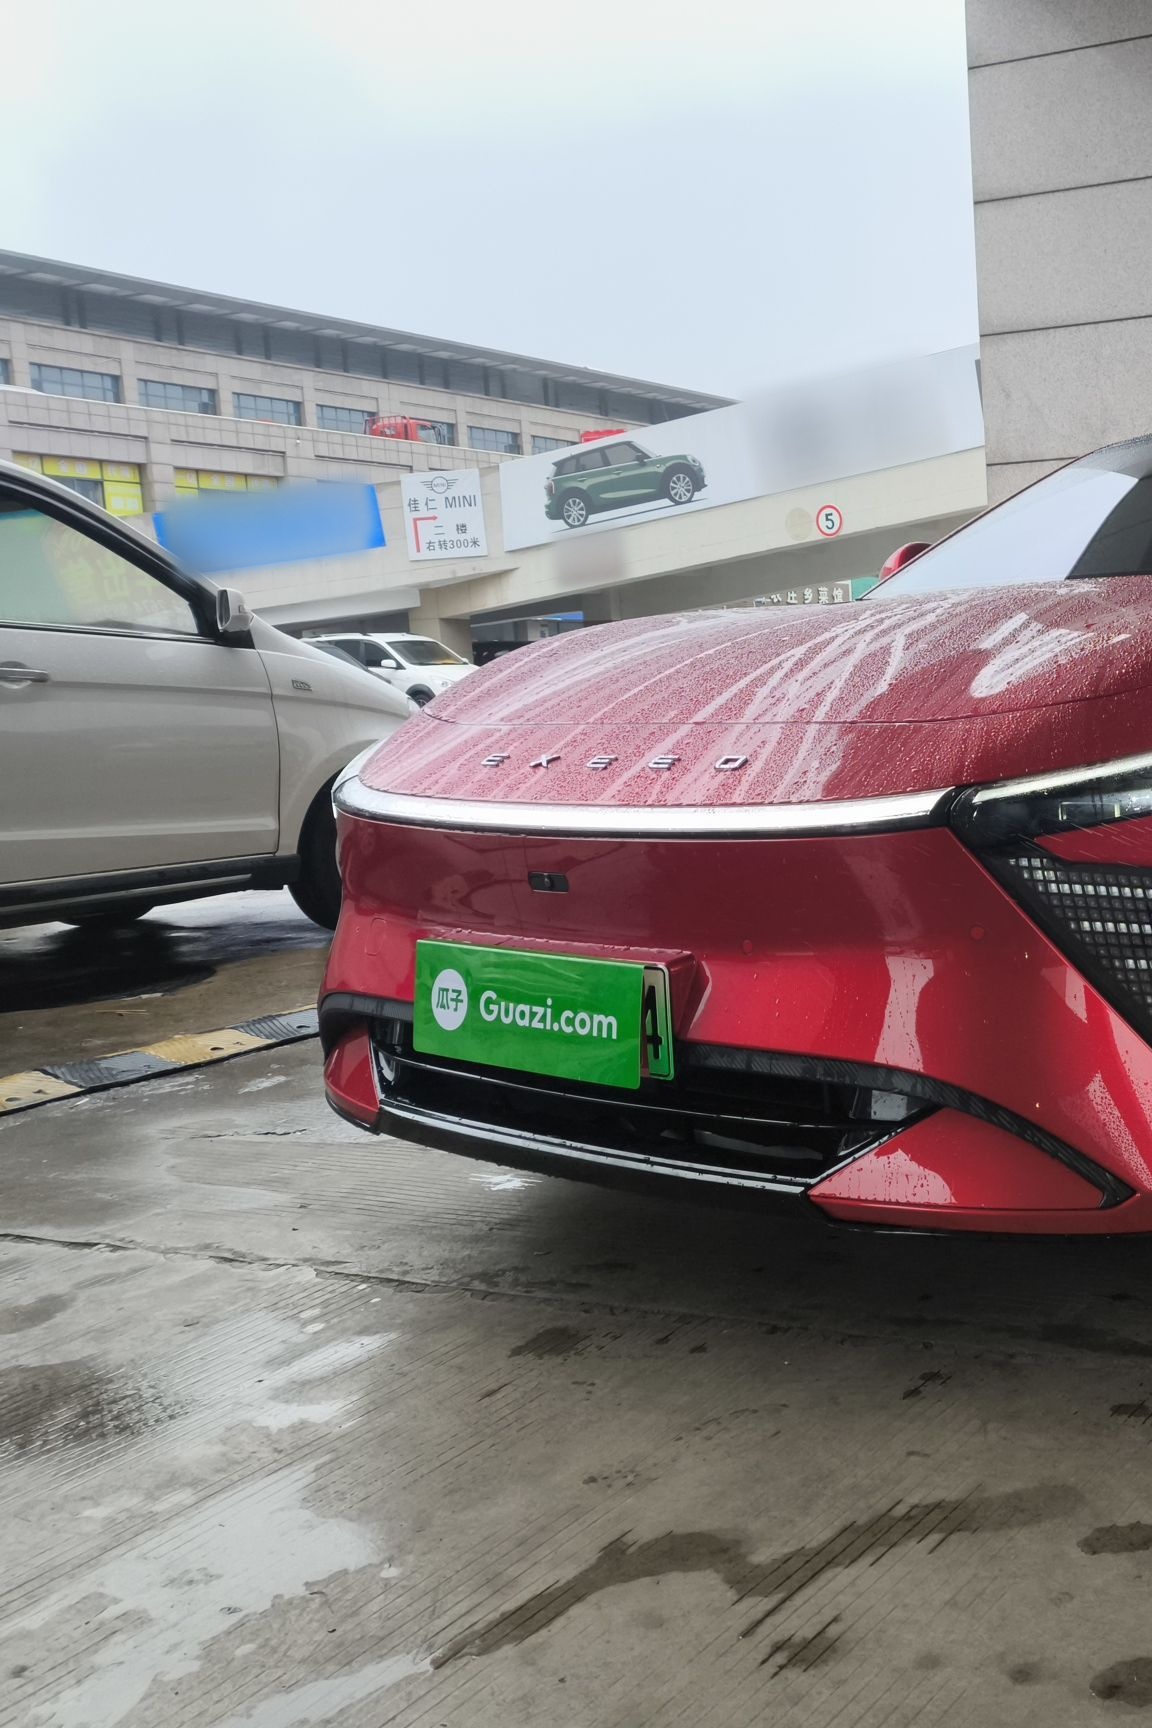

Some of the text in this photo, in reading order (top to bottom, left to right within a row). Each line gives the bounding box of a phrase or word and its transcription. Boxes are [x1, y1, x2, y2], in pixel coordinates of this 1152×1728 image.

[407, 494, 477, 513] 佳仁 MINI
[434, 523, 468, 536] 二楼
[825, 512, 834, 531] 5
[425, 536, 481, 552] 右转300米
[481, 752, 749, 772] EXEED
[436, 987, 618, 1040] 瓜子 Guazi.com
